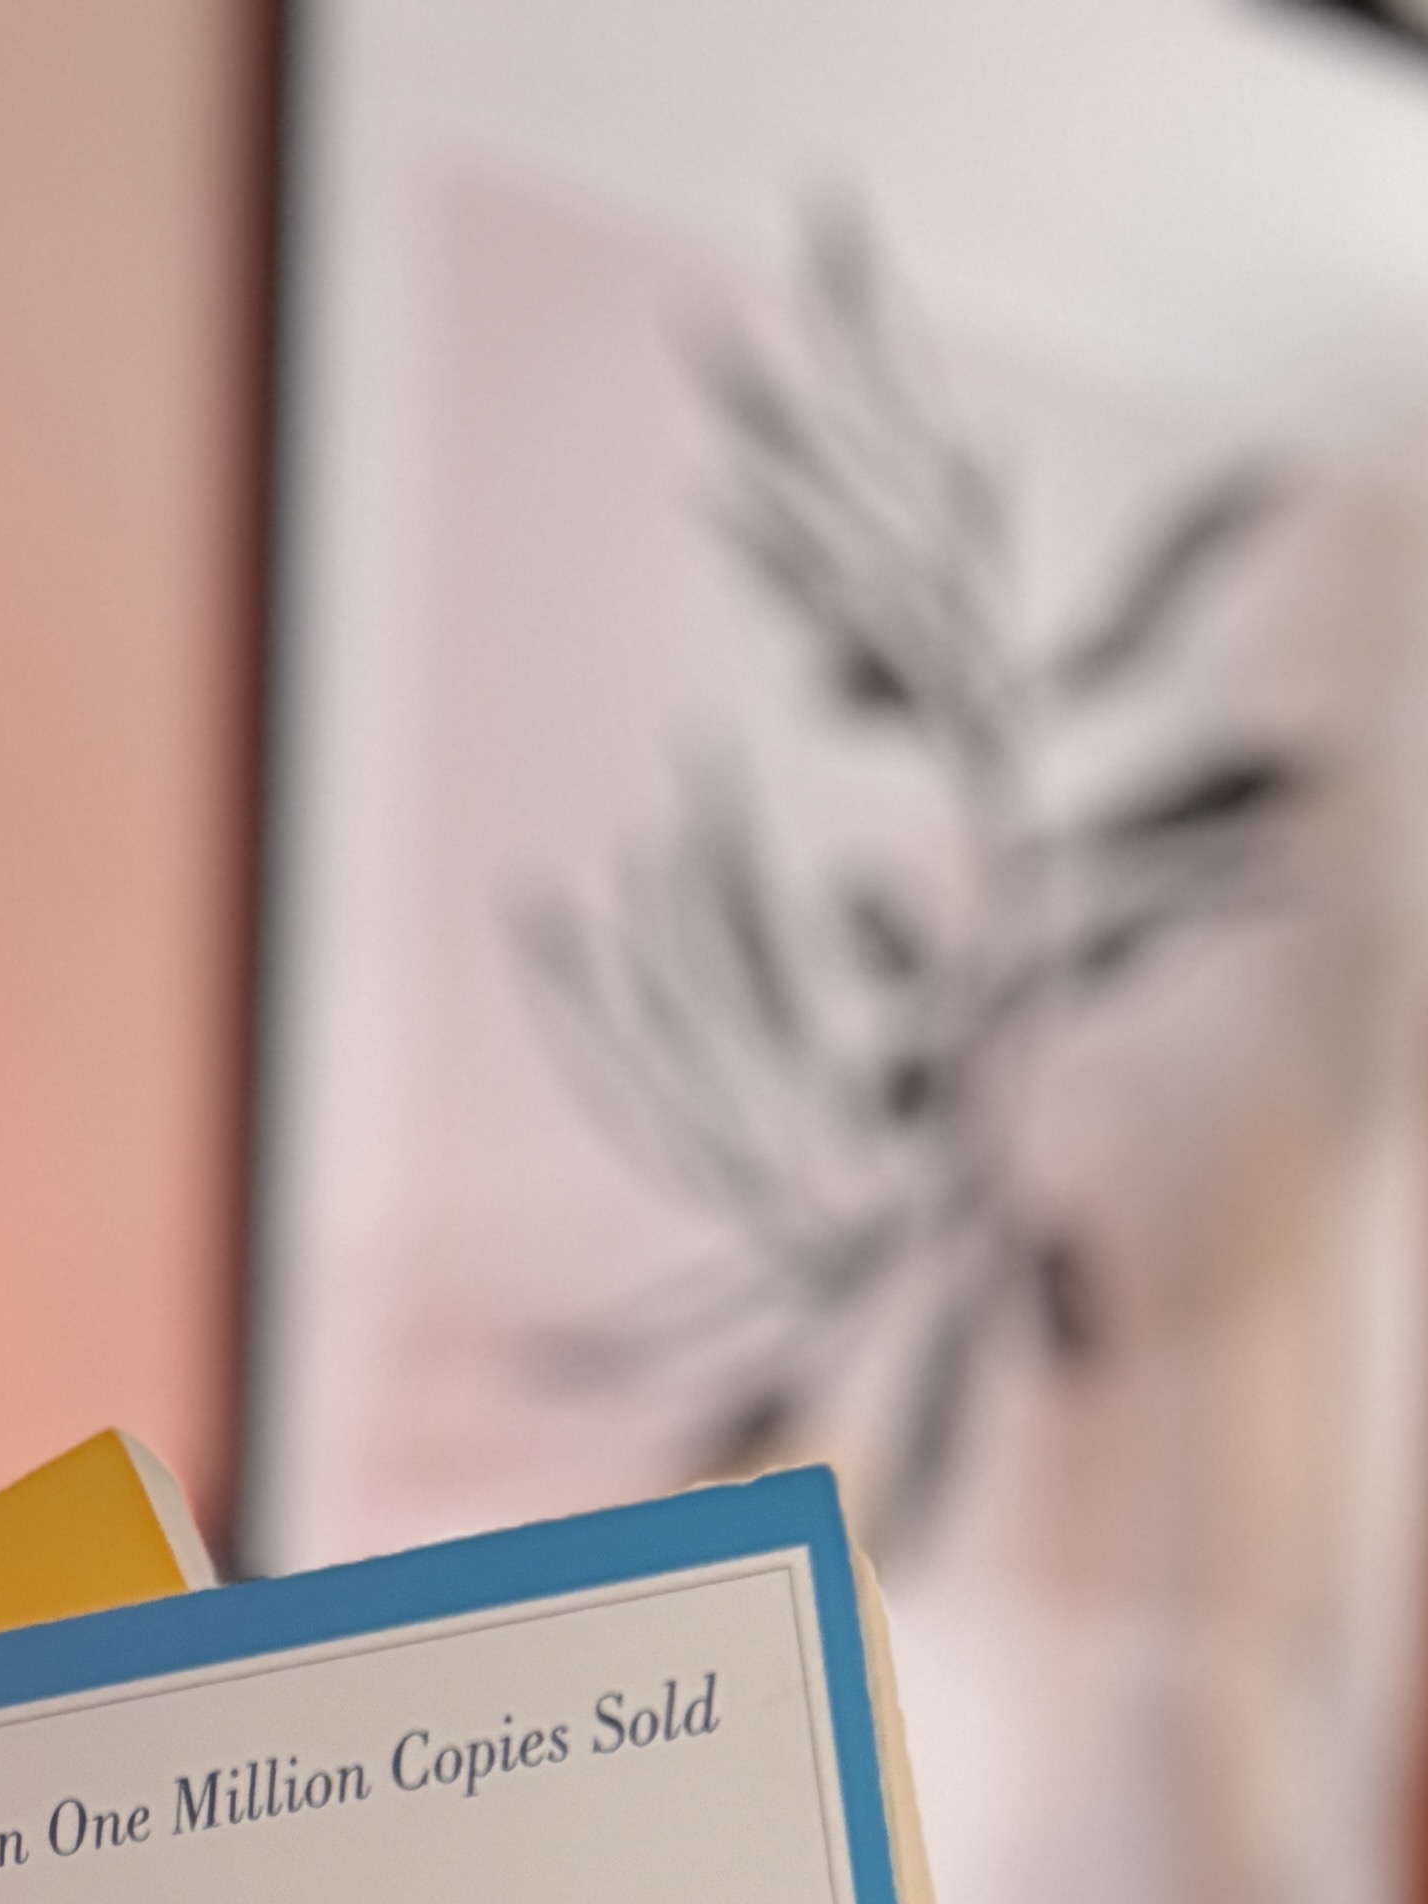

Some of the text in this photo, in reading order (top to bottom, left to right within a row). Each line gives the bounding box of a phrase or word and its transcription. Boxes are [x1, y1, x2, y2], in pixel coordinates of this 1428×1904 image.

[49, 1796, 152, 1858] One
[172, 1756, 372, 1836] Million
[392, 1716, 569, 1797] Copies
[591, 1673, 720, 1756] Sold
